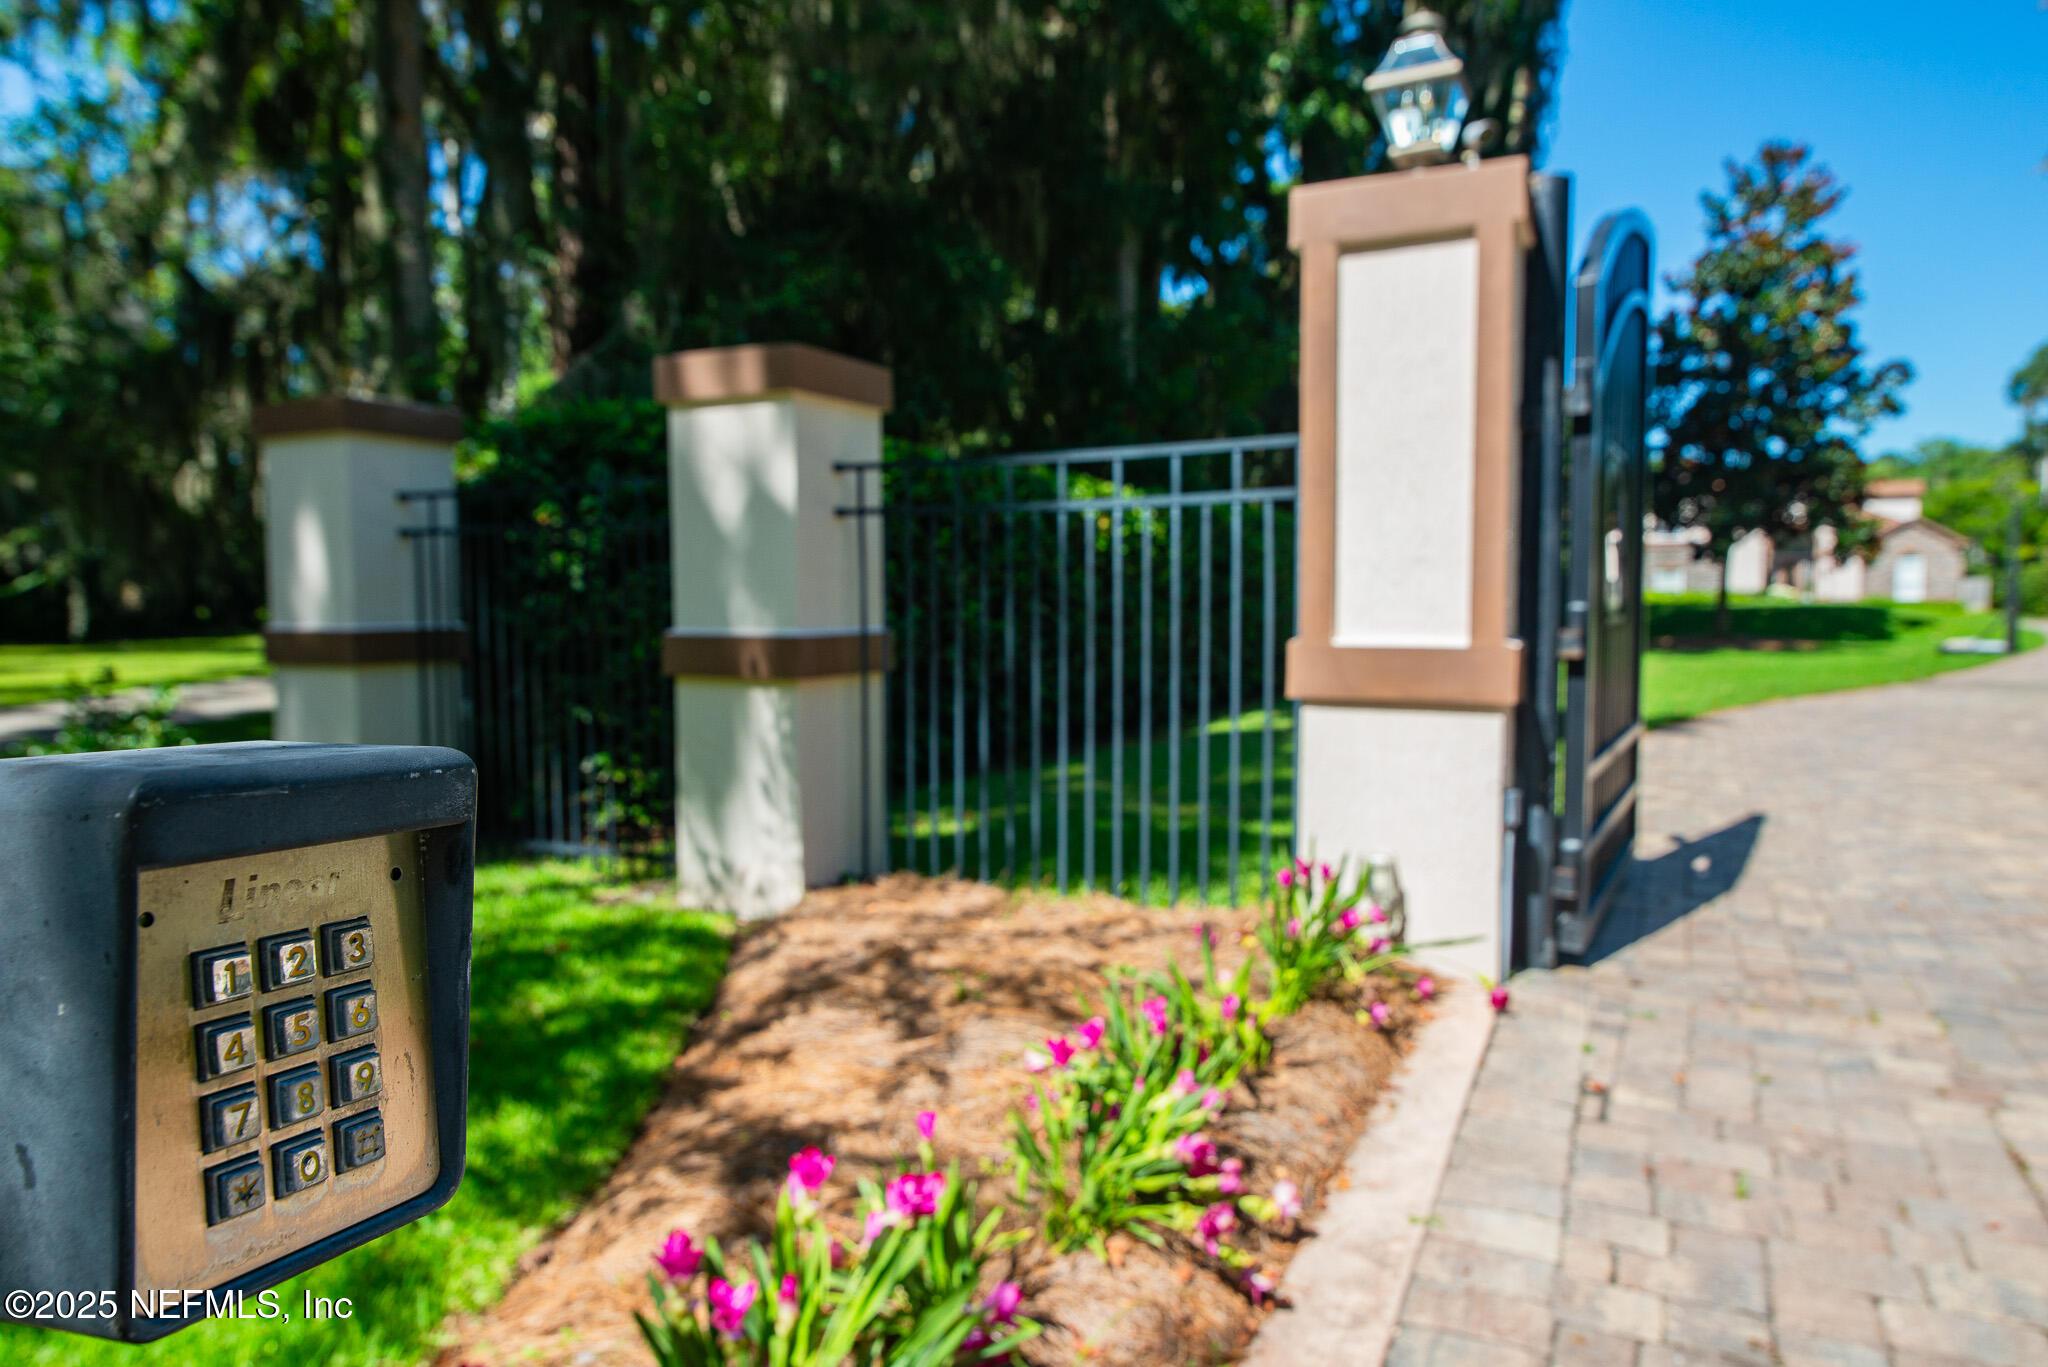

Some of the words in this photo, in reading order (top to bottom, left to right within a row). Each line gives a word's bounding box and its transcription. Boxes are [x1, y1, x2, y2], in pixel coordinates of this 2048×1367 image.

[224, 962, 236, 995] 1
[289, 945, 306, 977] 2
[349, 933, 364, 962] 3
[223, 1032, 246, 1064] 4
[293, 1013, 311, 1046] 5
[353, 998, 370, 1028] 6
[230, 1103, 251, 1137] 7
[298, 1082, 313, 1114] 8
[355, 1062, 374, 1091] 9
[299, 1151, 319, 1182] 0
